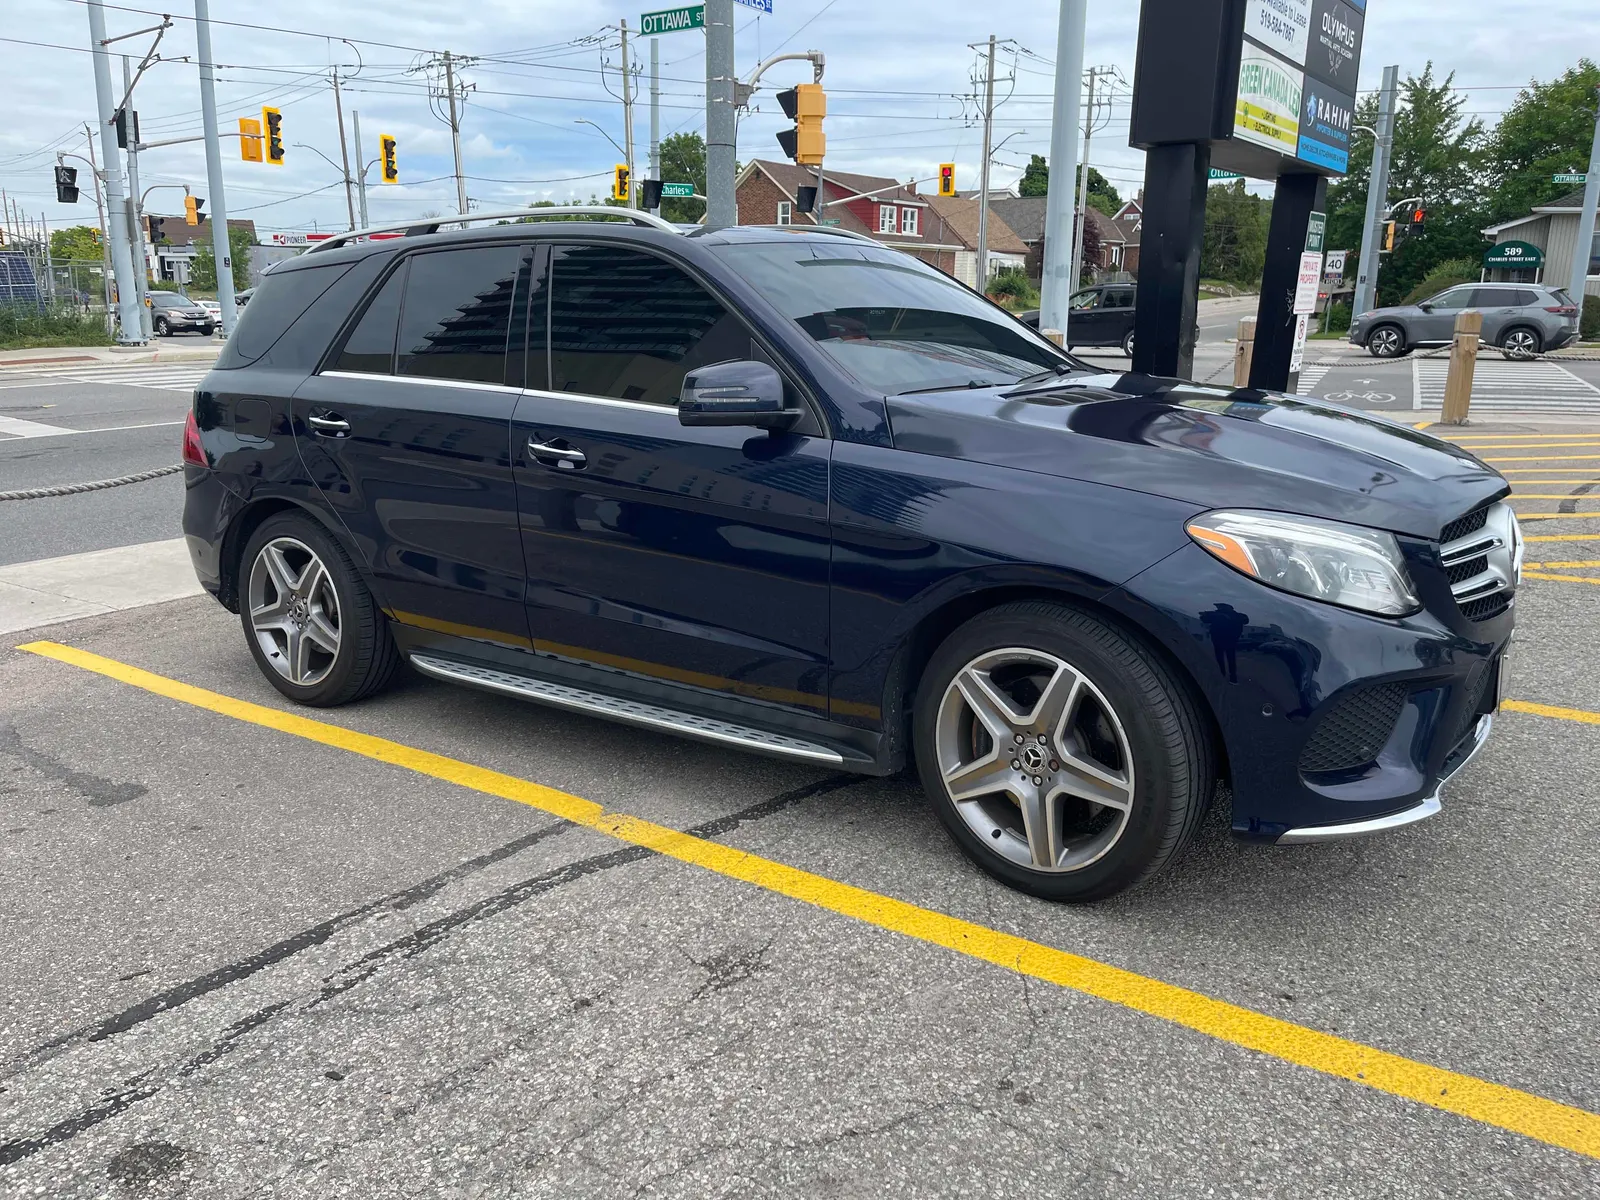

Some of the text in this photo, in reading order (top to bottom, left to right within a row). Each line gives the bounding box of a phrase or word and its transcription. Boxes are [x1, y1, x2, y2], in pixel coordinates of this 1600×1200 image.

[642, 10, 692, 33] OTTAWA
[1294, 6, 1307, 28] Lease
[1322, 12, 1355, 49] OLYMPUS
[1239, 64, 1301, 118] GREEN CANADA LED
[1317, 98, 1351, 131] RAHIM
[661, 185, 685, 195] Charles
[286, 236, 307, 244] PIONEER
[1504, 247, 1522, 256] 589
[1328, 259, 1342, 270] 40
